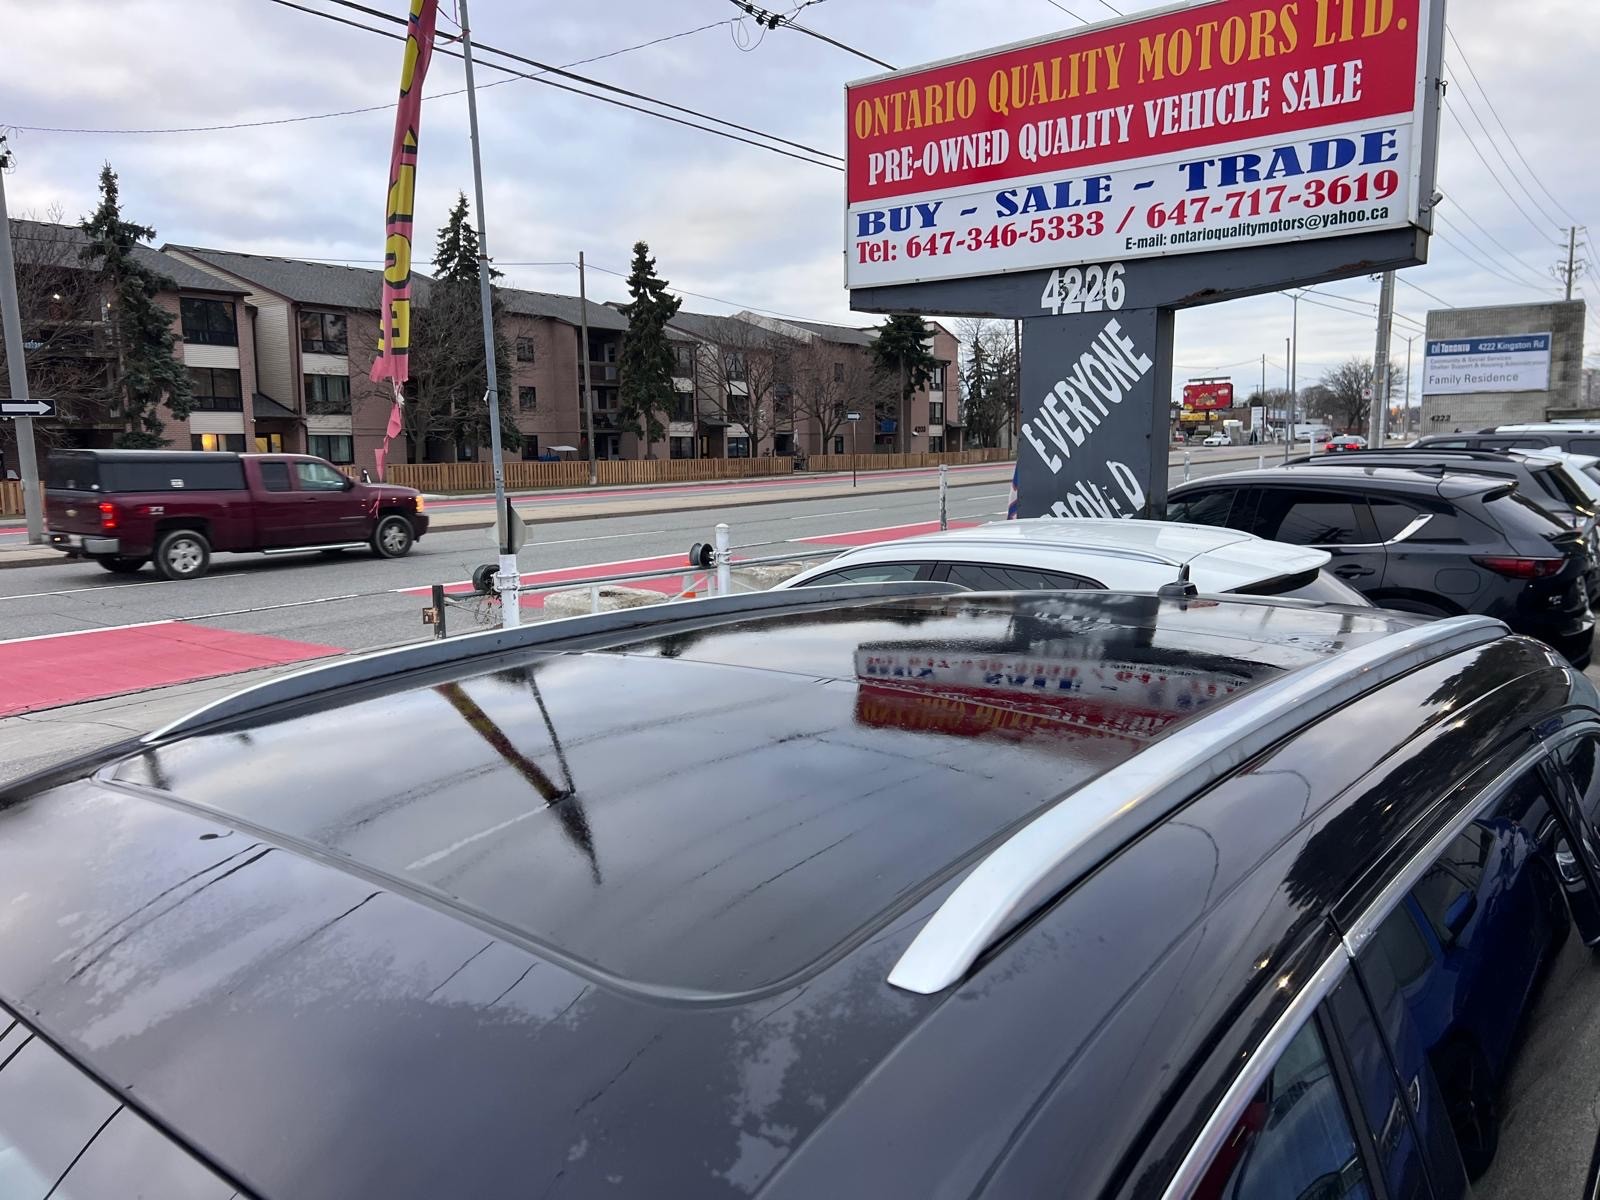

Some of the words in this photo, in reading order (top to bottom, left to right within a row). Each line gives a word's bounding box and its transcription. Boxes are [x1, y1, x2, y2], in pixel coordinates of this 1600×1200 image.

[855, 76, 977, 139] ONTARIO
[988, 43, 1126, 117] QUALITY
[1138, 2, 1298, 84] MOTORS
[1313, 0, 1408, 48] LTD.
[868, 128, 1010, 186] PRE-OWNED
[1018, 104, 1134, 163] QUALITY
[1144, 77, 1270, 138] VEHICLE
[1282, 59, 1362, 115] SALE
[856, 201, 943, 238] BUY
[995, 175, 1112, 218] SALE
[1178, 129, 1398, 192] TRADE
[857, 239, 897, 264] Tel:
[906, 211, 1104, 259] 647-346-5333
[1115, 205, 1135, 234] /
[1146, 169, 1398, 229] 647-717-3619
[1125, 233, 1167, 250] E-mail:
[1170, 206, 1389, 245] ontarioqualitymotors@yahoo.ca
[1041, 262, 1126, 315] 4226
[1429, 374, 1461, 385] Family
[1464, 372, 1519, 383] Residence
[1478, 342, 1496, 351] 4222
[1497, 342, 1531, 351] Kingston
[1533, 340, 1544, 349] Rd
[1021, 317, 1153, 475] EVERYONE
